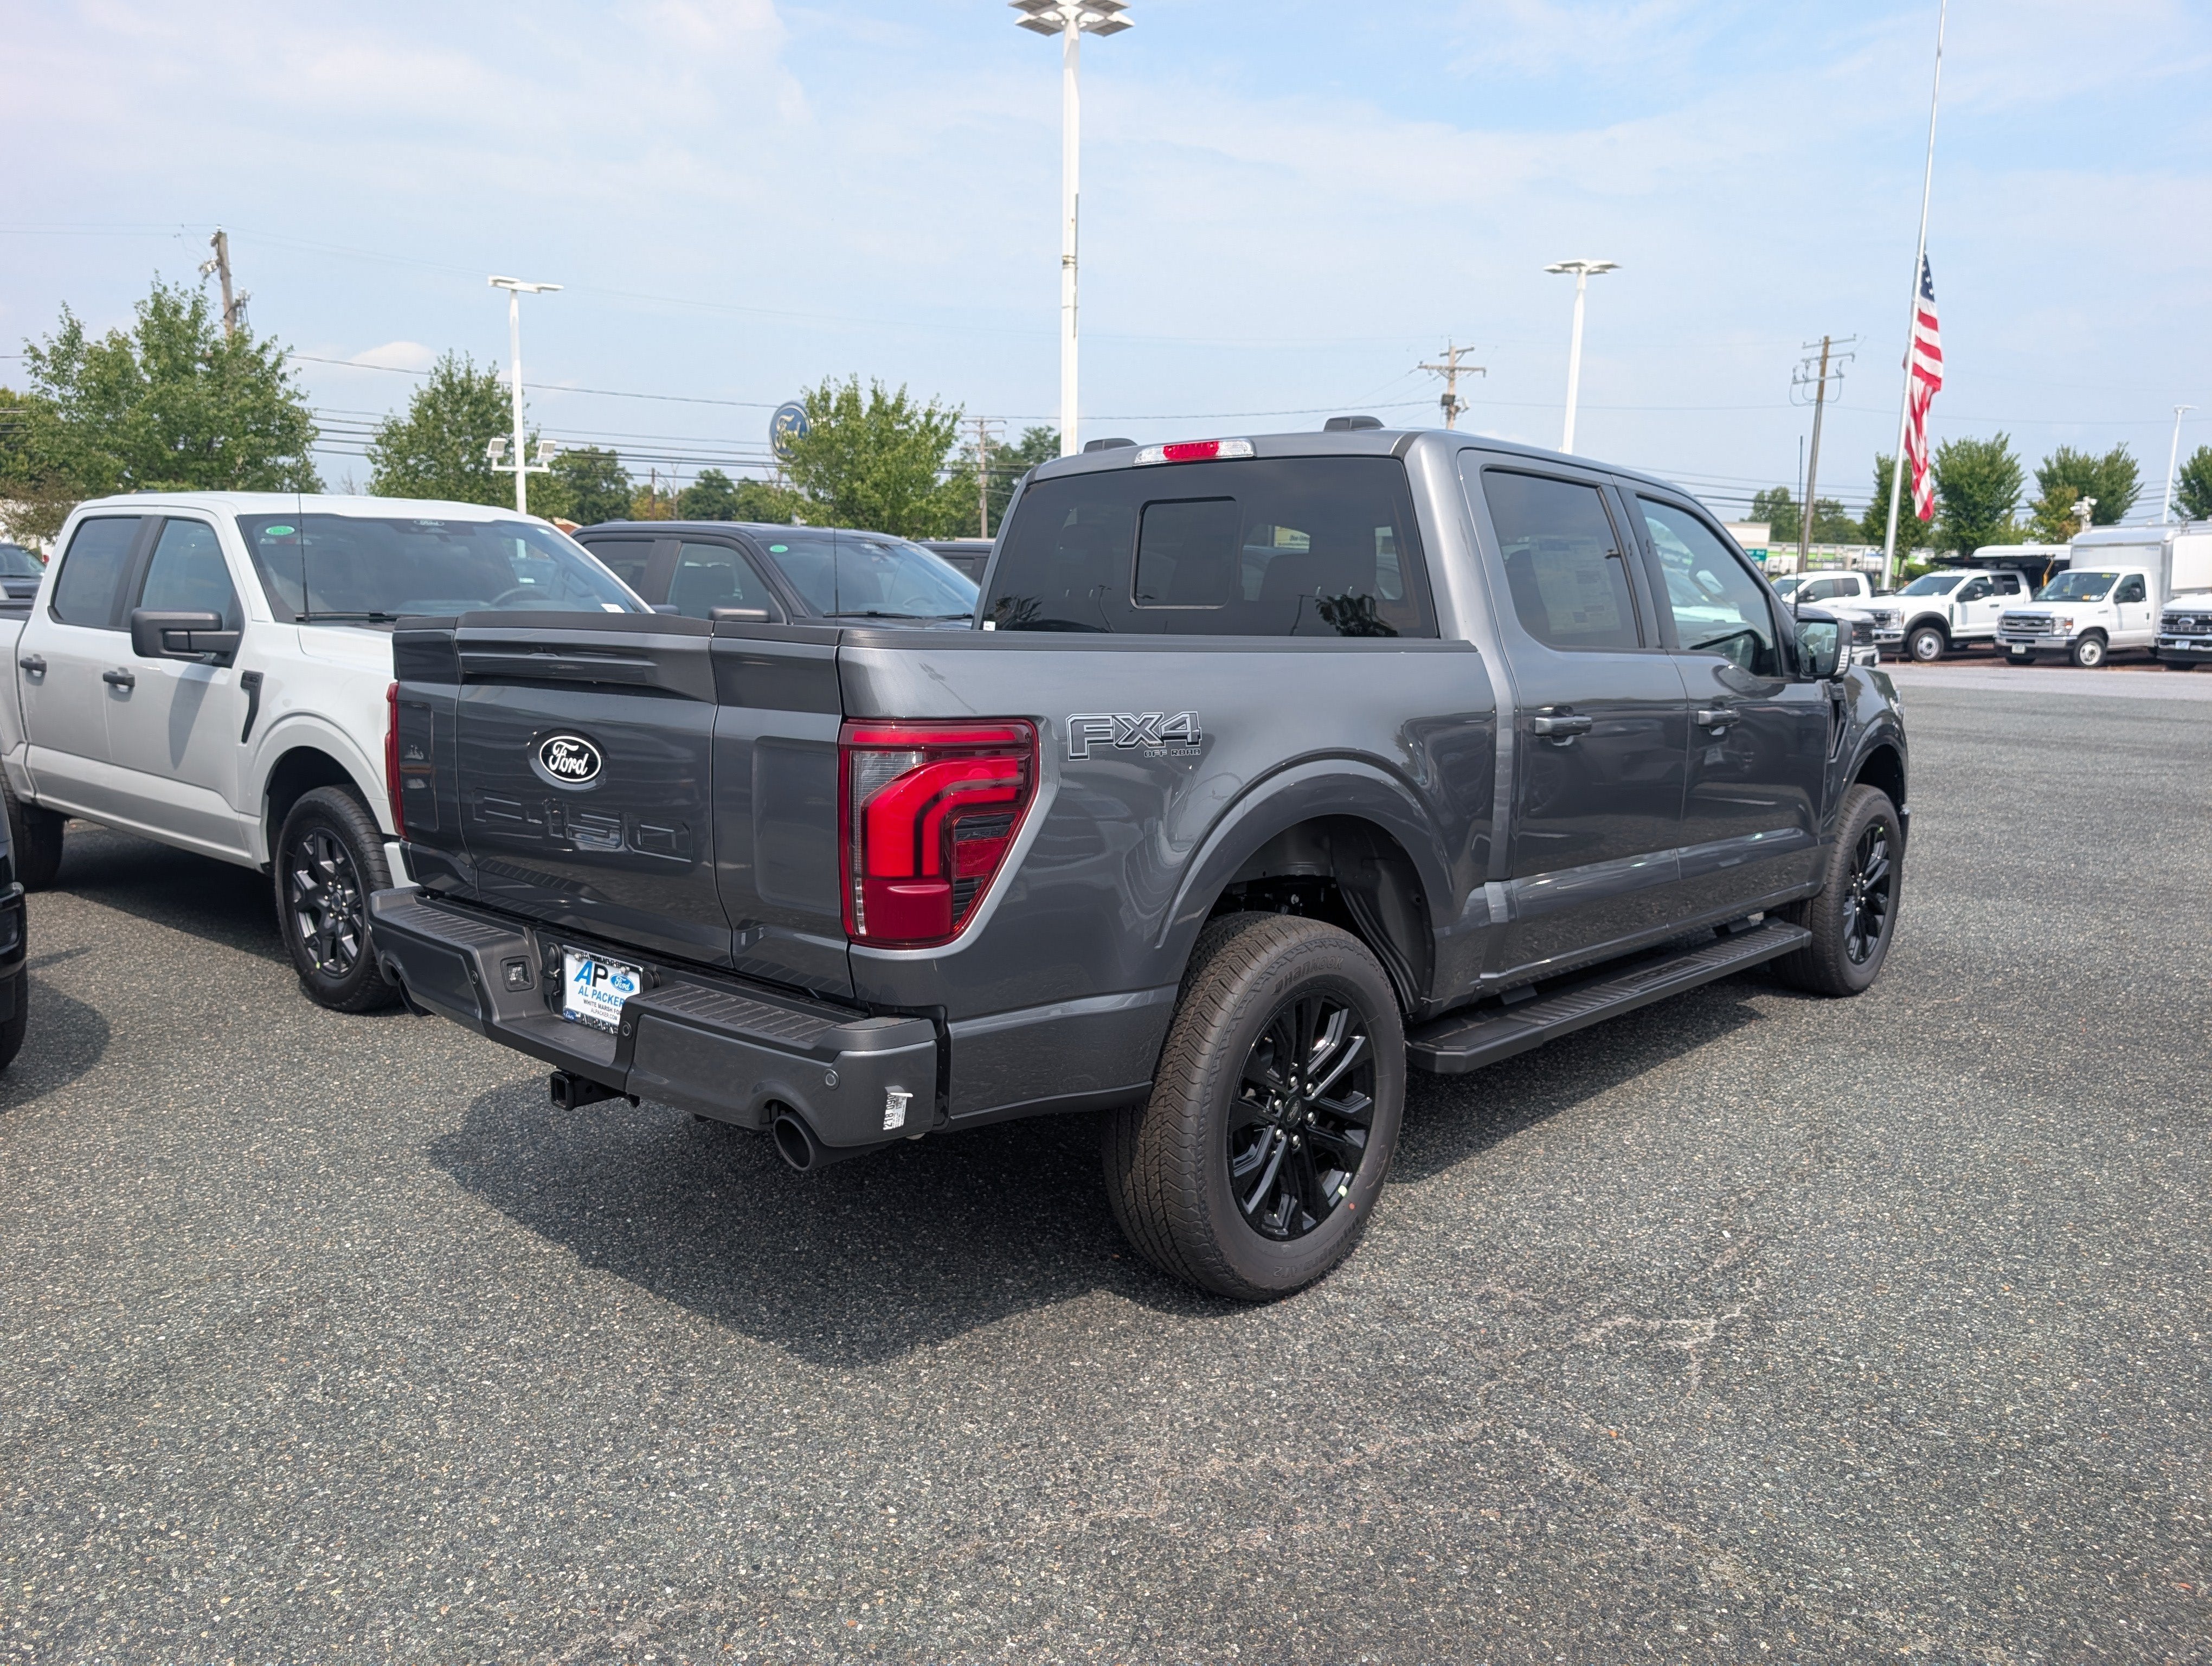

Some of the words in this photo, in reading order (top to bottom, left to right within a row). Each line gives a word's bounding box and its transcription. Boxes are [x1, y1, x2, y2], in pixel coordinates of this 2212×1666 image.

[1065, 712, 1202, 761] FX4
[549, 740, 589, 776] Ford
[1143, 749, 1167, 758] OFF
[1171, 748, 1201, 757] ROAD
[574, 960, 608, 987] AP
[578, 985, 588, 997] AL
[583, 998, 597, 1008] WHITE
[598, 1003, 613, 1013] MARSH
[591, 1008, 618, 1020] ALPACKER.COM
[593, 1018, 618, 1035] PACKE
